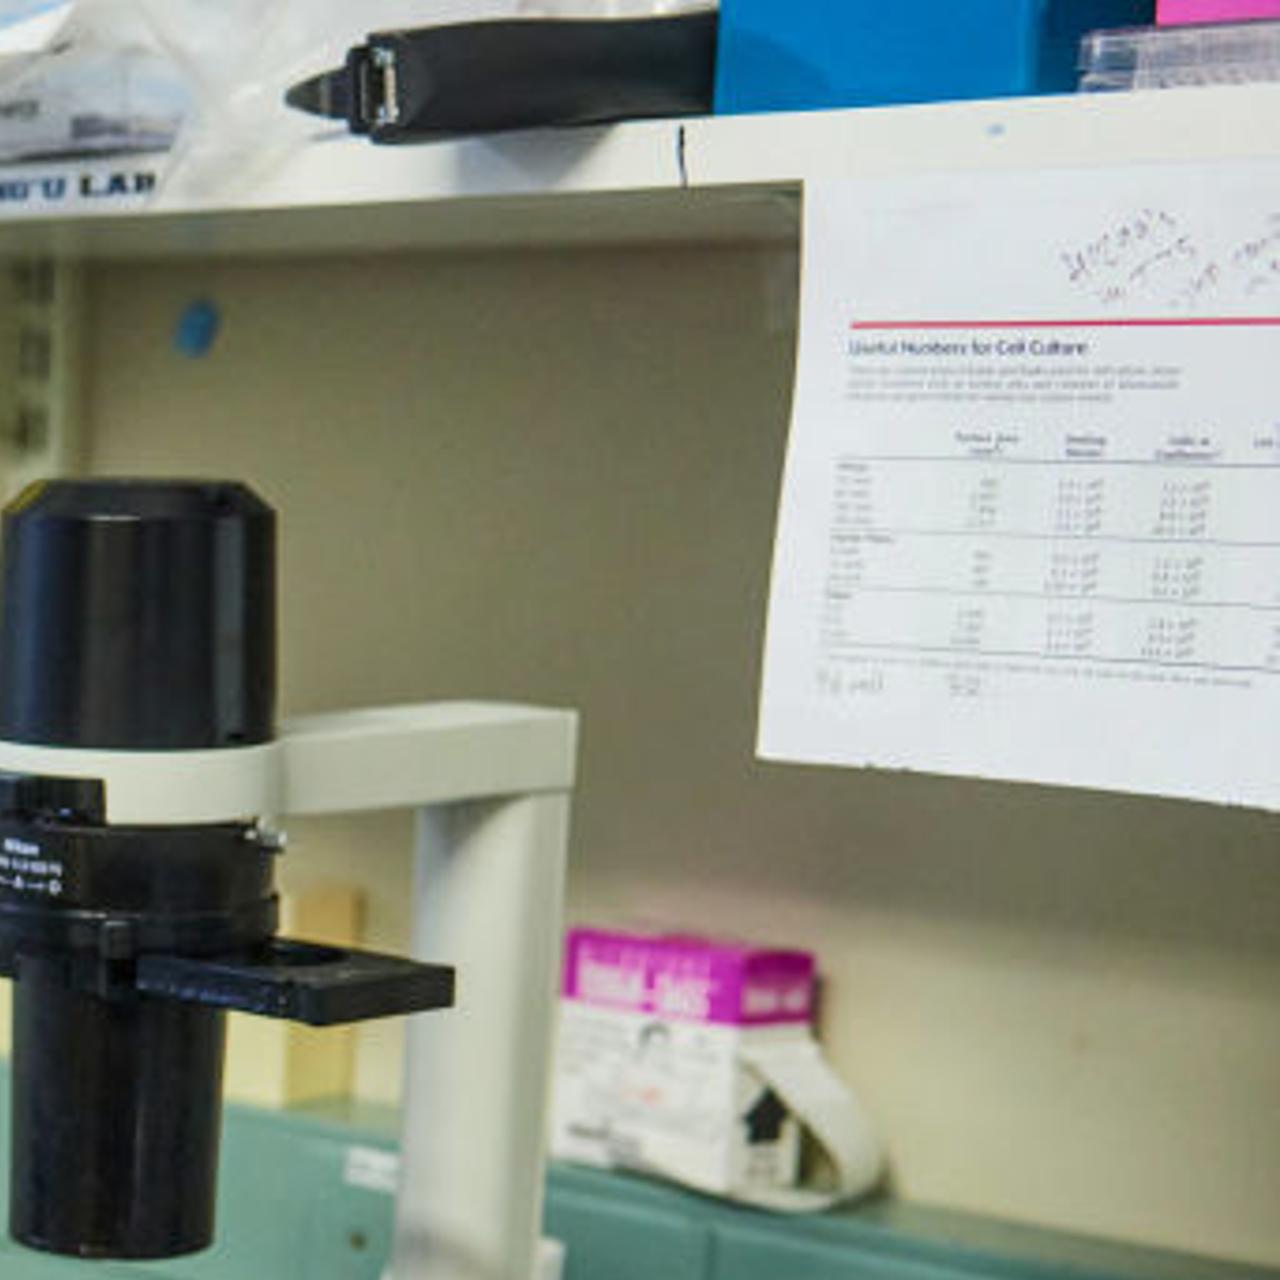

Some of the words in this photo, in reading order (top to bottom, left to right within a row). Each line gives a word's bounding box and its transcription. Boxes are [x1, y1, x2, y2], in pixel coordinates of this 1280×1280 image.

[849, 341, 897, 356] Useful
[901, 340, 968, 357] Numbers
[971, 340, 994, 356] for
[997, 340, 1026, 356] Cell
[1030, 339, 1087, 356] Culture
